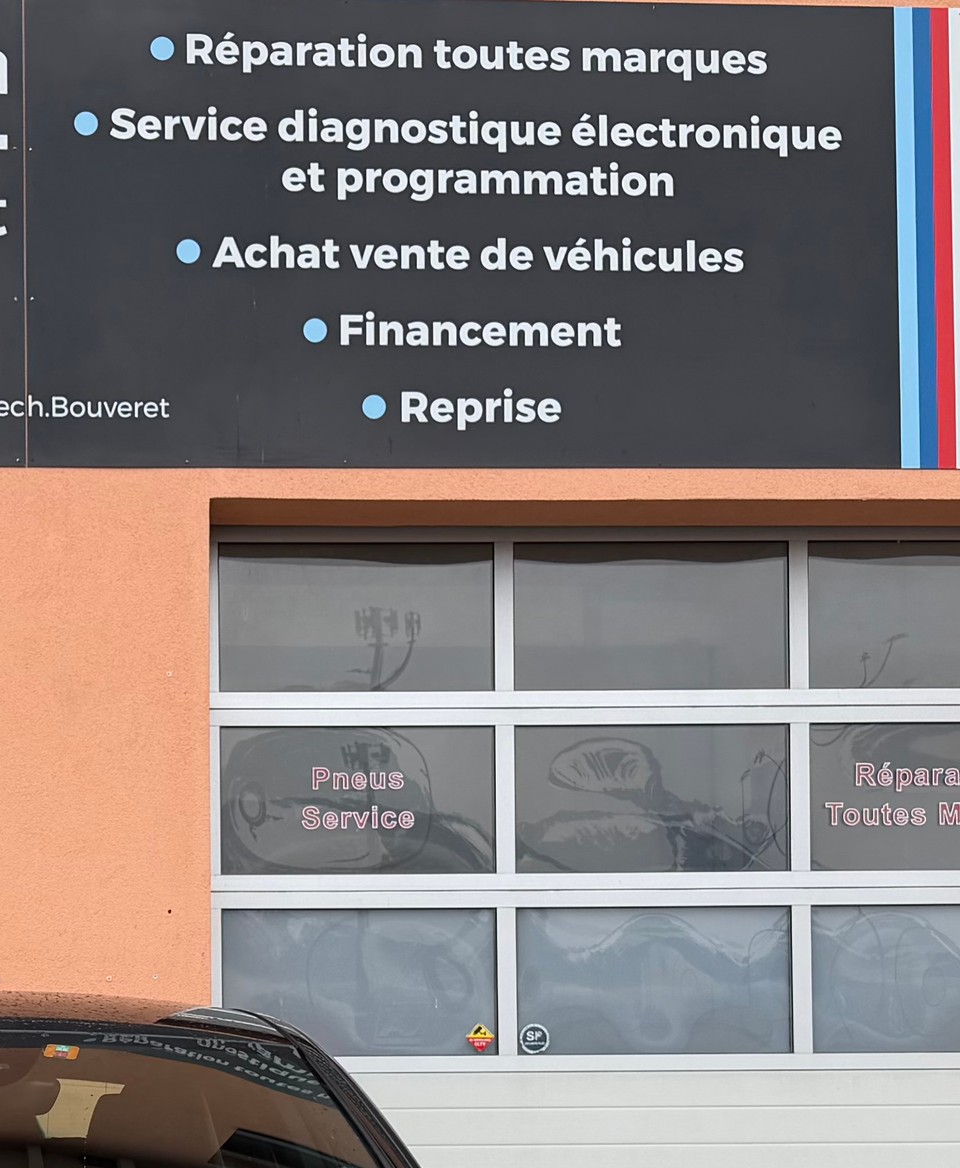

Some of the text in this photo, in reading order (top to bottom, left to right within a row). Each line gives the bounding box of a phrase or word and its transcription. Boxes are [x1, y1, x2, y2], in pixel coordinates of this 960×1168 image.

[186, 31, 768, 82] Réparation toutes marques
[109, 106, 842, 157] Service diagnostique électronique
[281, 161, 675, 203] et programmation
[212, 235, 744, 274] Achat vente de véhicules
[339, 311, 622, 348] Financement
[400, 387, 563, 431] Reprise
[311, 766, 406, 792] Pneus
[854, 761, 960, 792] Répara
[300, 804, 416, 831] Service
[824, 801, 927, 827] Toutes
